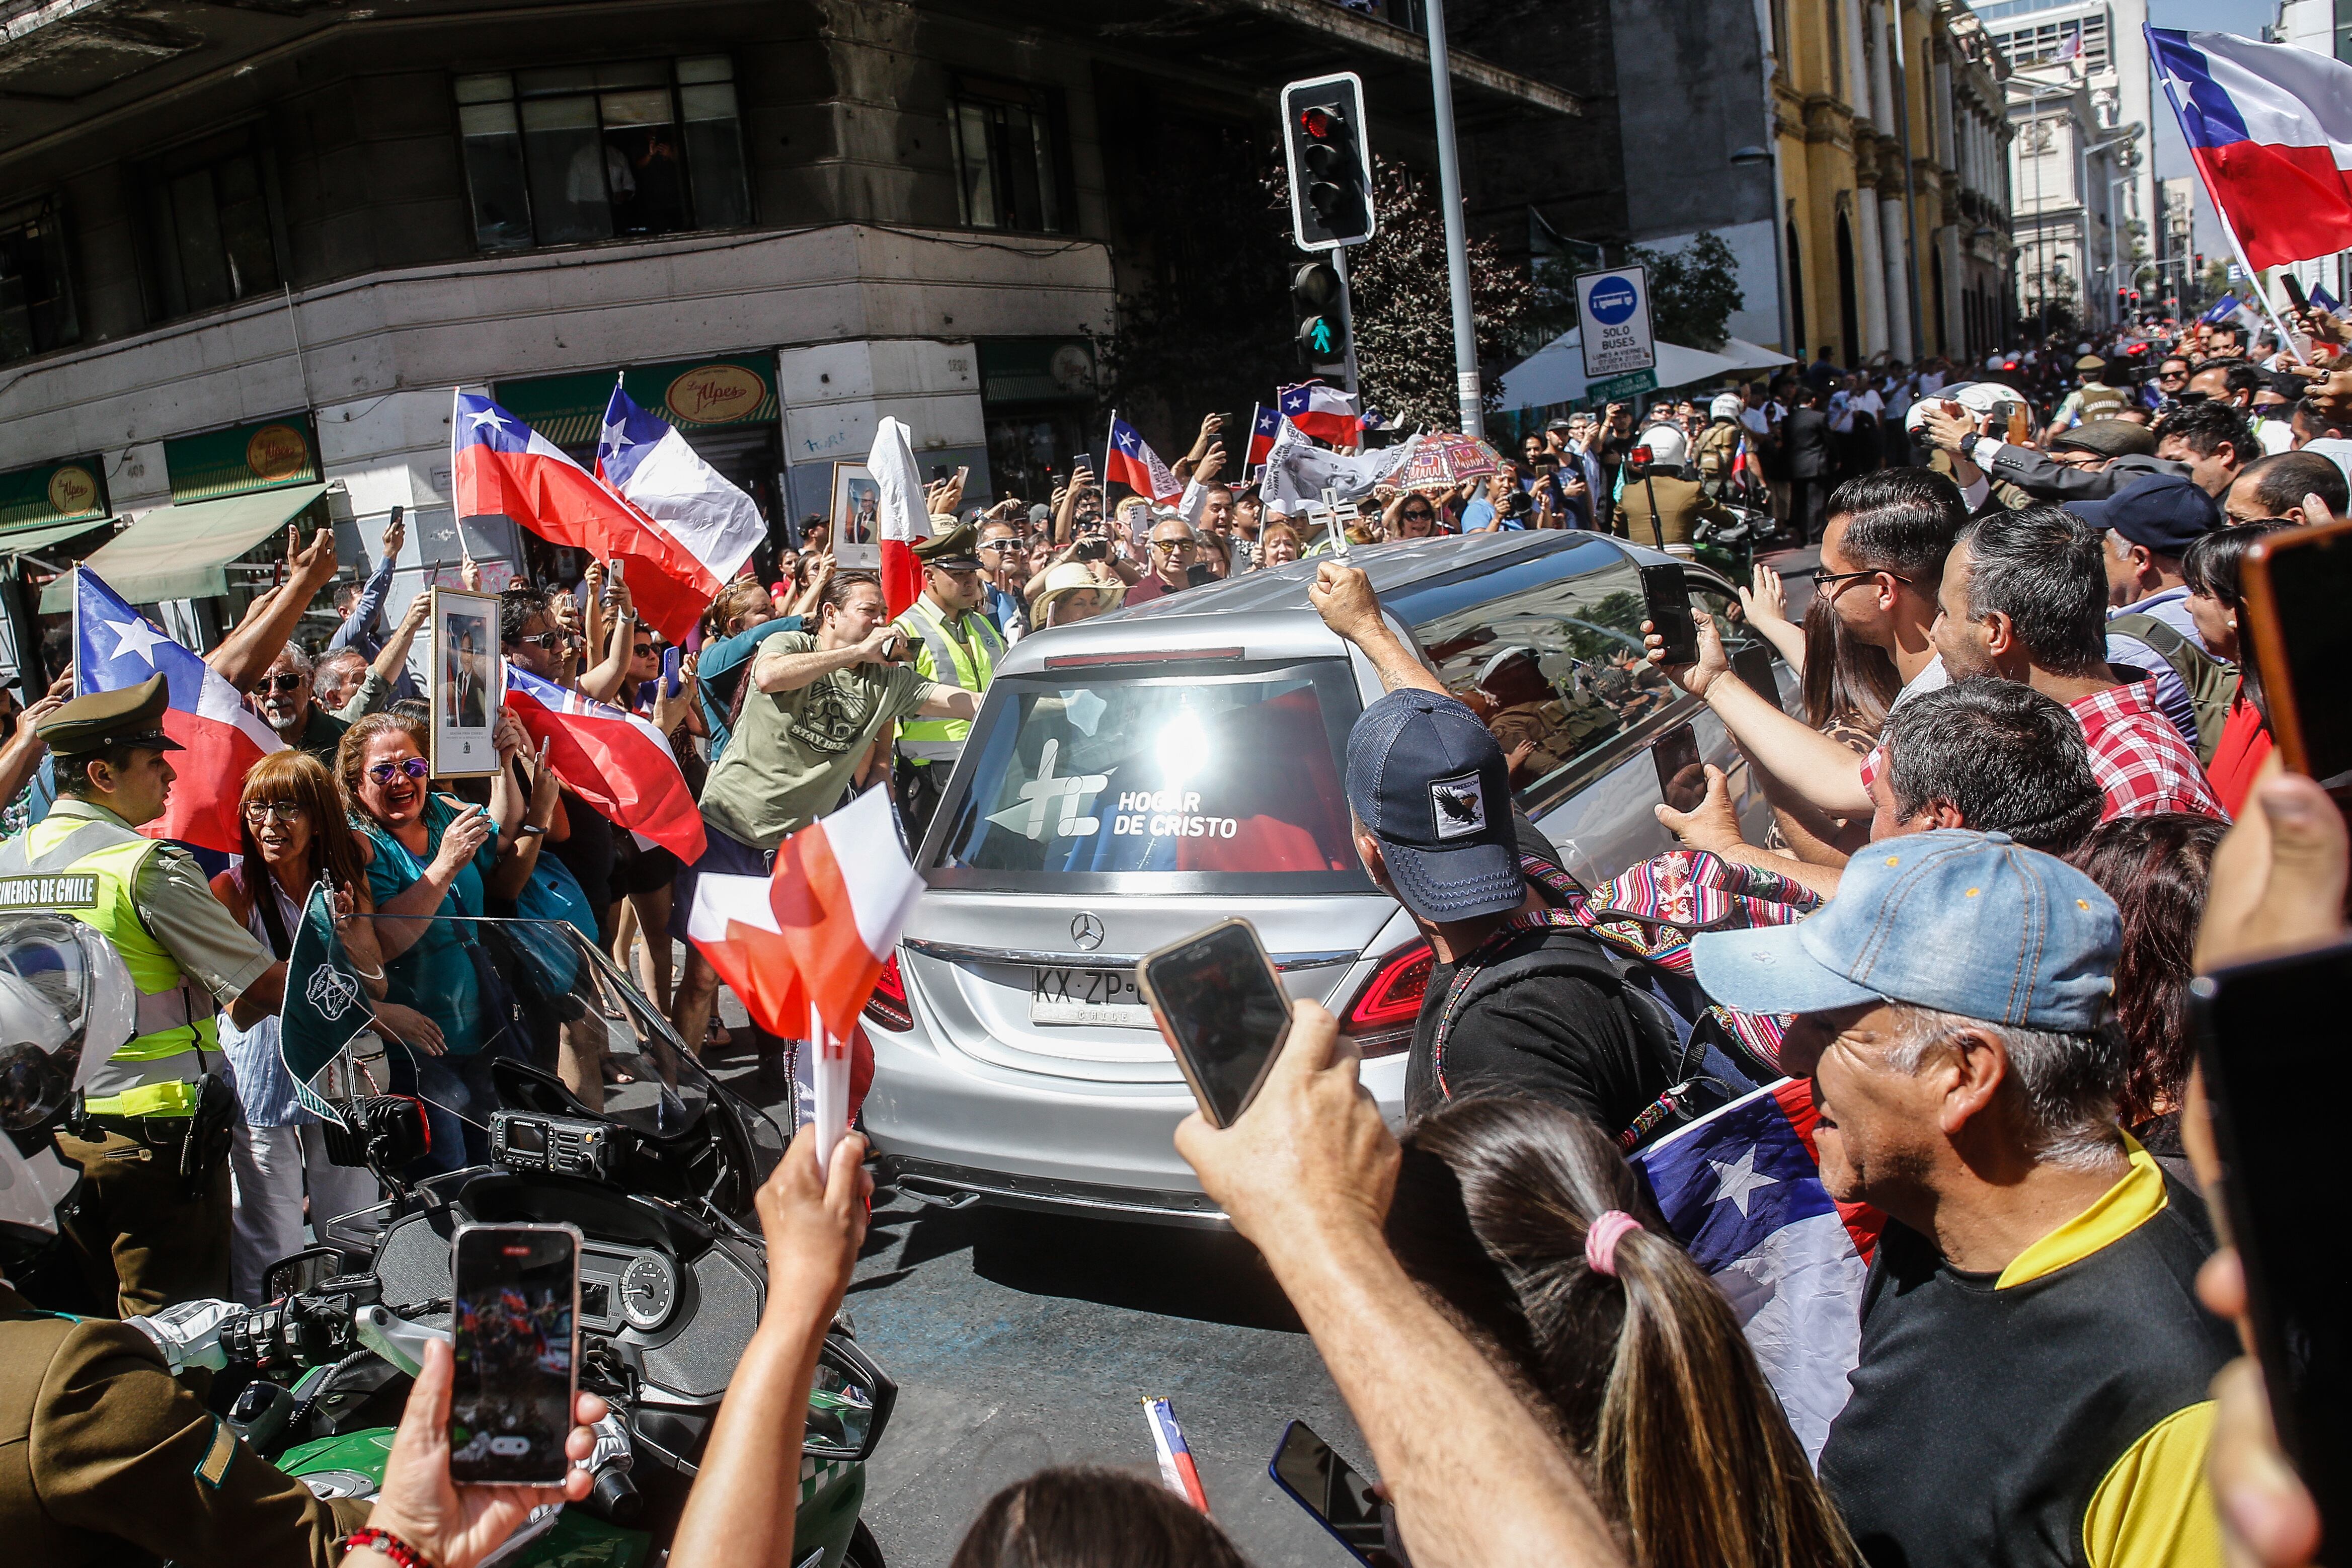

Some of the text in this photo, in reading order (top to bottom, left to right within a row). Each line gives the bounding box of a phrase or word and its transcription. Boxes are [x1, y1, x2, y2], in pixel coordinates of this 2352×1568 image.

[1603, 326, 1629, 338] SOLO
[1602, 337, 1635, 350] BUSES
[694, 381, 747, 415] Alpes
[63, 481, 88, 508] Alpes
[792, 725, 824, 746] STAY
[1453, 778, 1478, 790] FREEDOM
[1118, 791, 1201, 813] HOGAR
[1113, 814, 1238, 838] DE CRISTO
[0, 878, 94, 905] INEROS DE CHILE
[1078, 1010, 1128, 1022] CHILE
